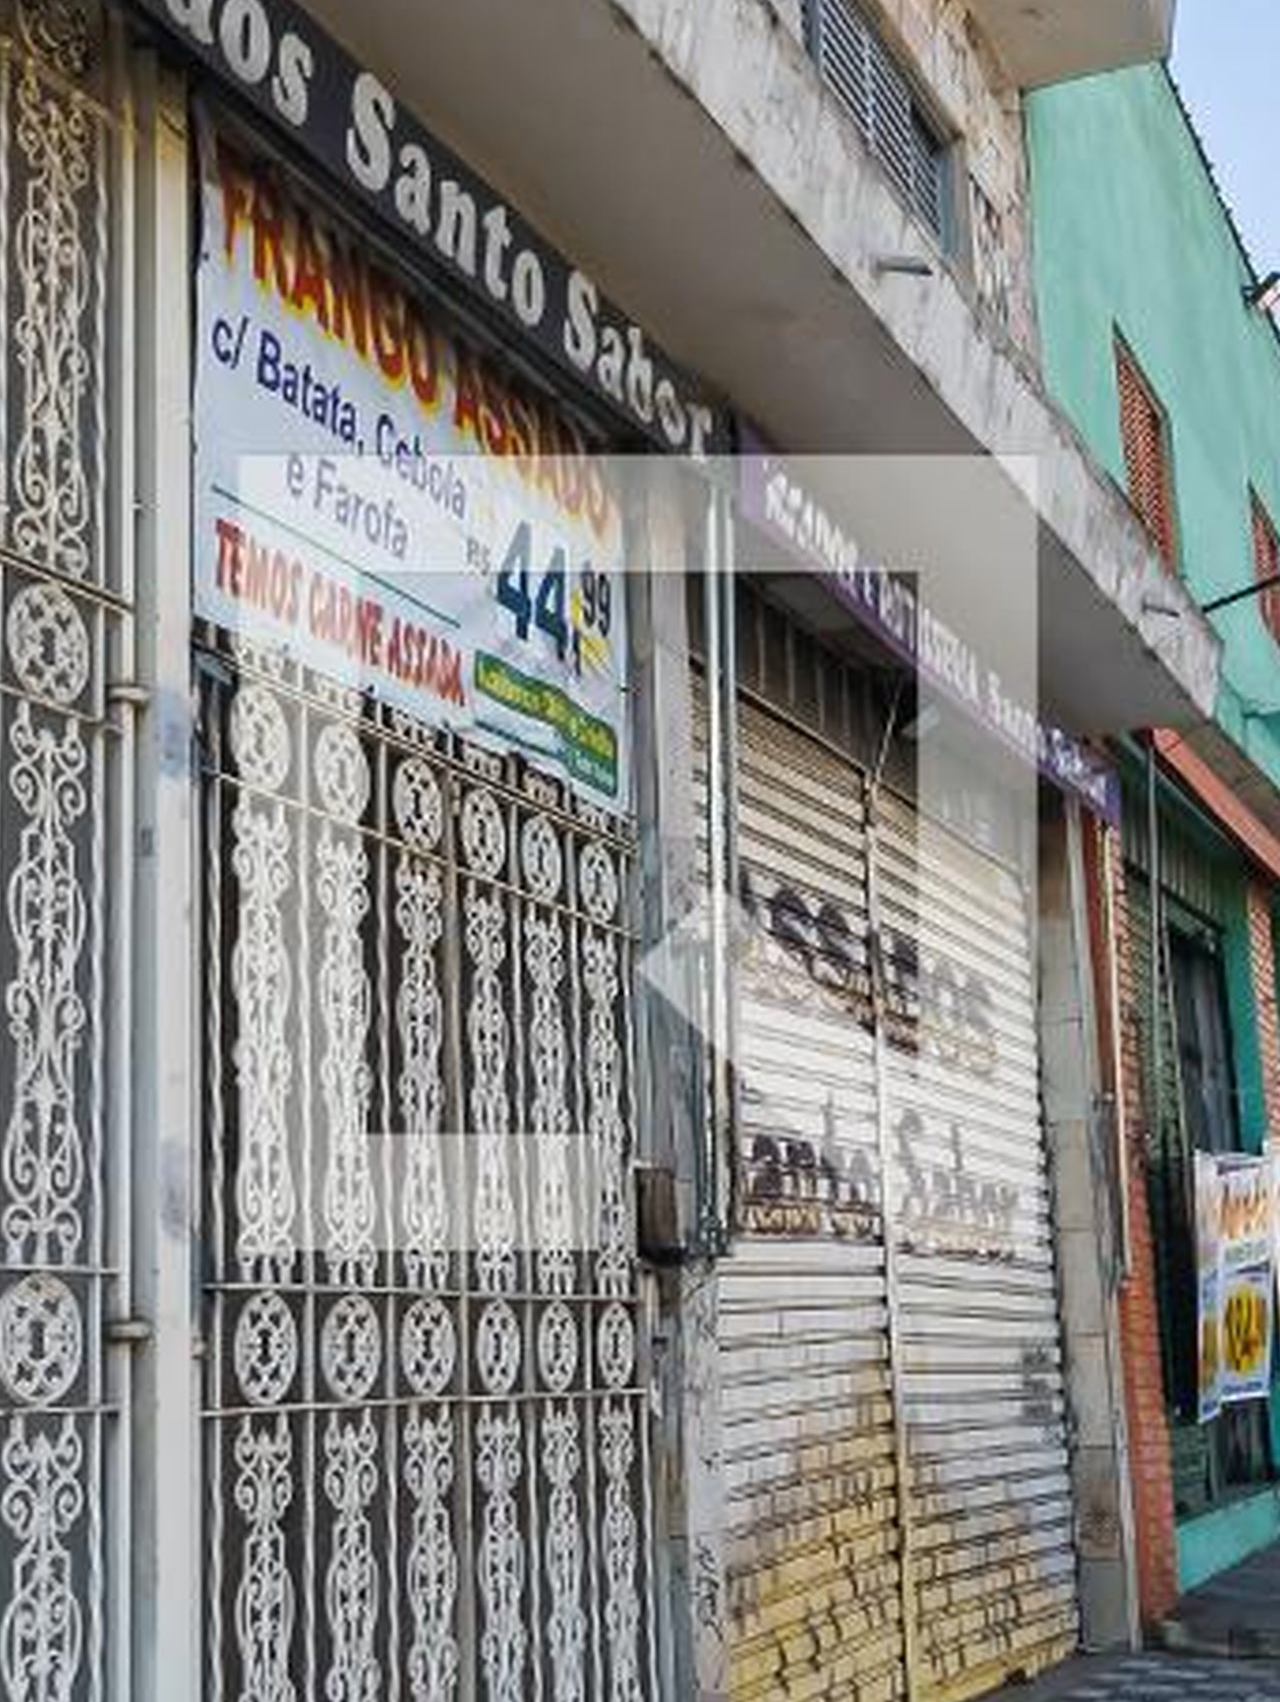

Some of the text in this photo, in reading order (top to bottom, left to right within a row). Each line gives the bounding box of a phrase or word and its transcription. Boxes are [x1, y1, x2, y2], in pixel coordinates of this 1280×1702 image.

[220, 155, 442, 415] FRANGO
[345, 71, 546, 328] Santo
[562, 270, 714, 463] Sabor
[211, 316, 466, 519] c/ Batata, Cebola
[286, 453, 409, 560] e Farofa
[216, 518, 466, 708] TEMOS CARNE ASSADA
